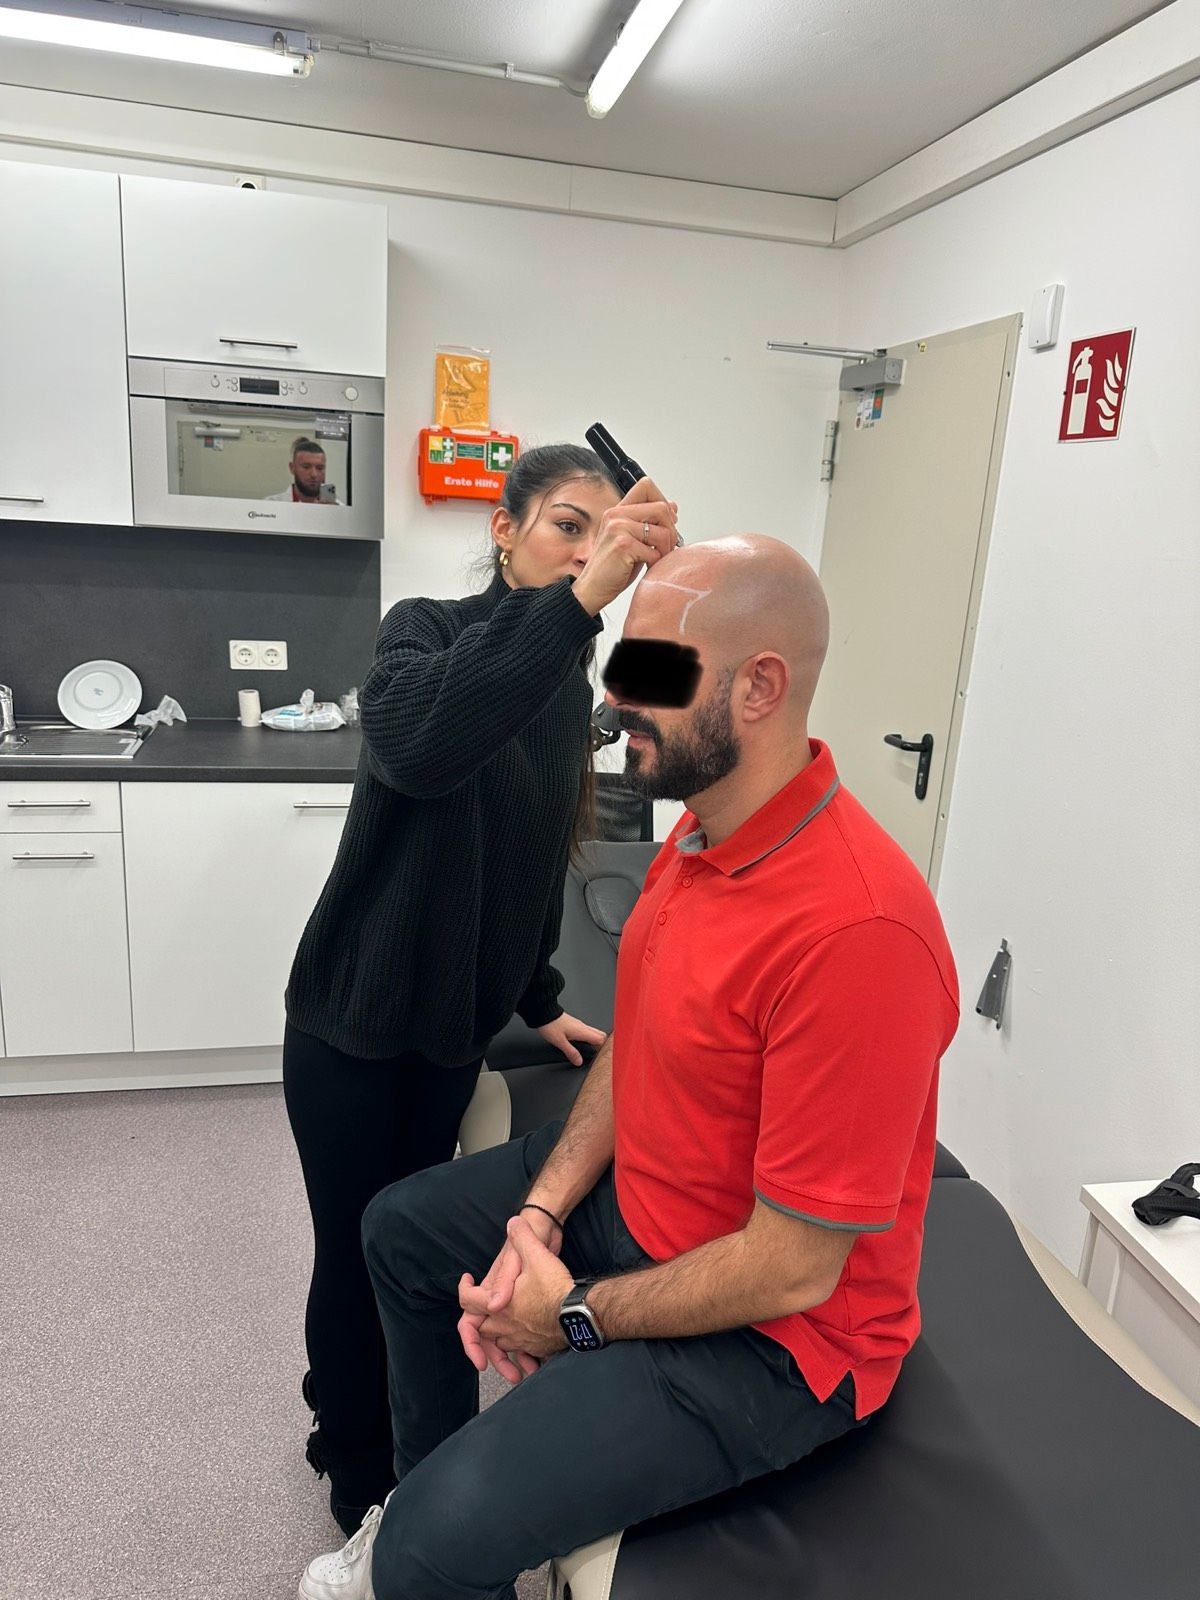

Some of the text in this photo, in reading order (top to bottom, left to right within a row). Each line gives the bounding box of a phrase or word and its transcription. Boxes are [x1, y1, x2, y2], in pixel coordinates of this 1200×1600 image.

[444, 476, 499, 488] Erste Hilfe
[569, 1323, 593, 1341] 17:27
